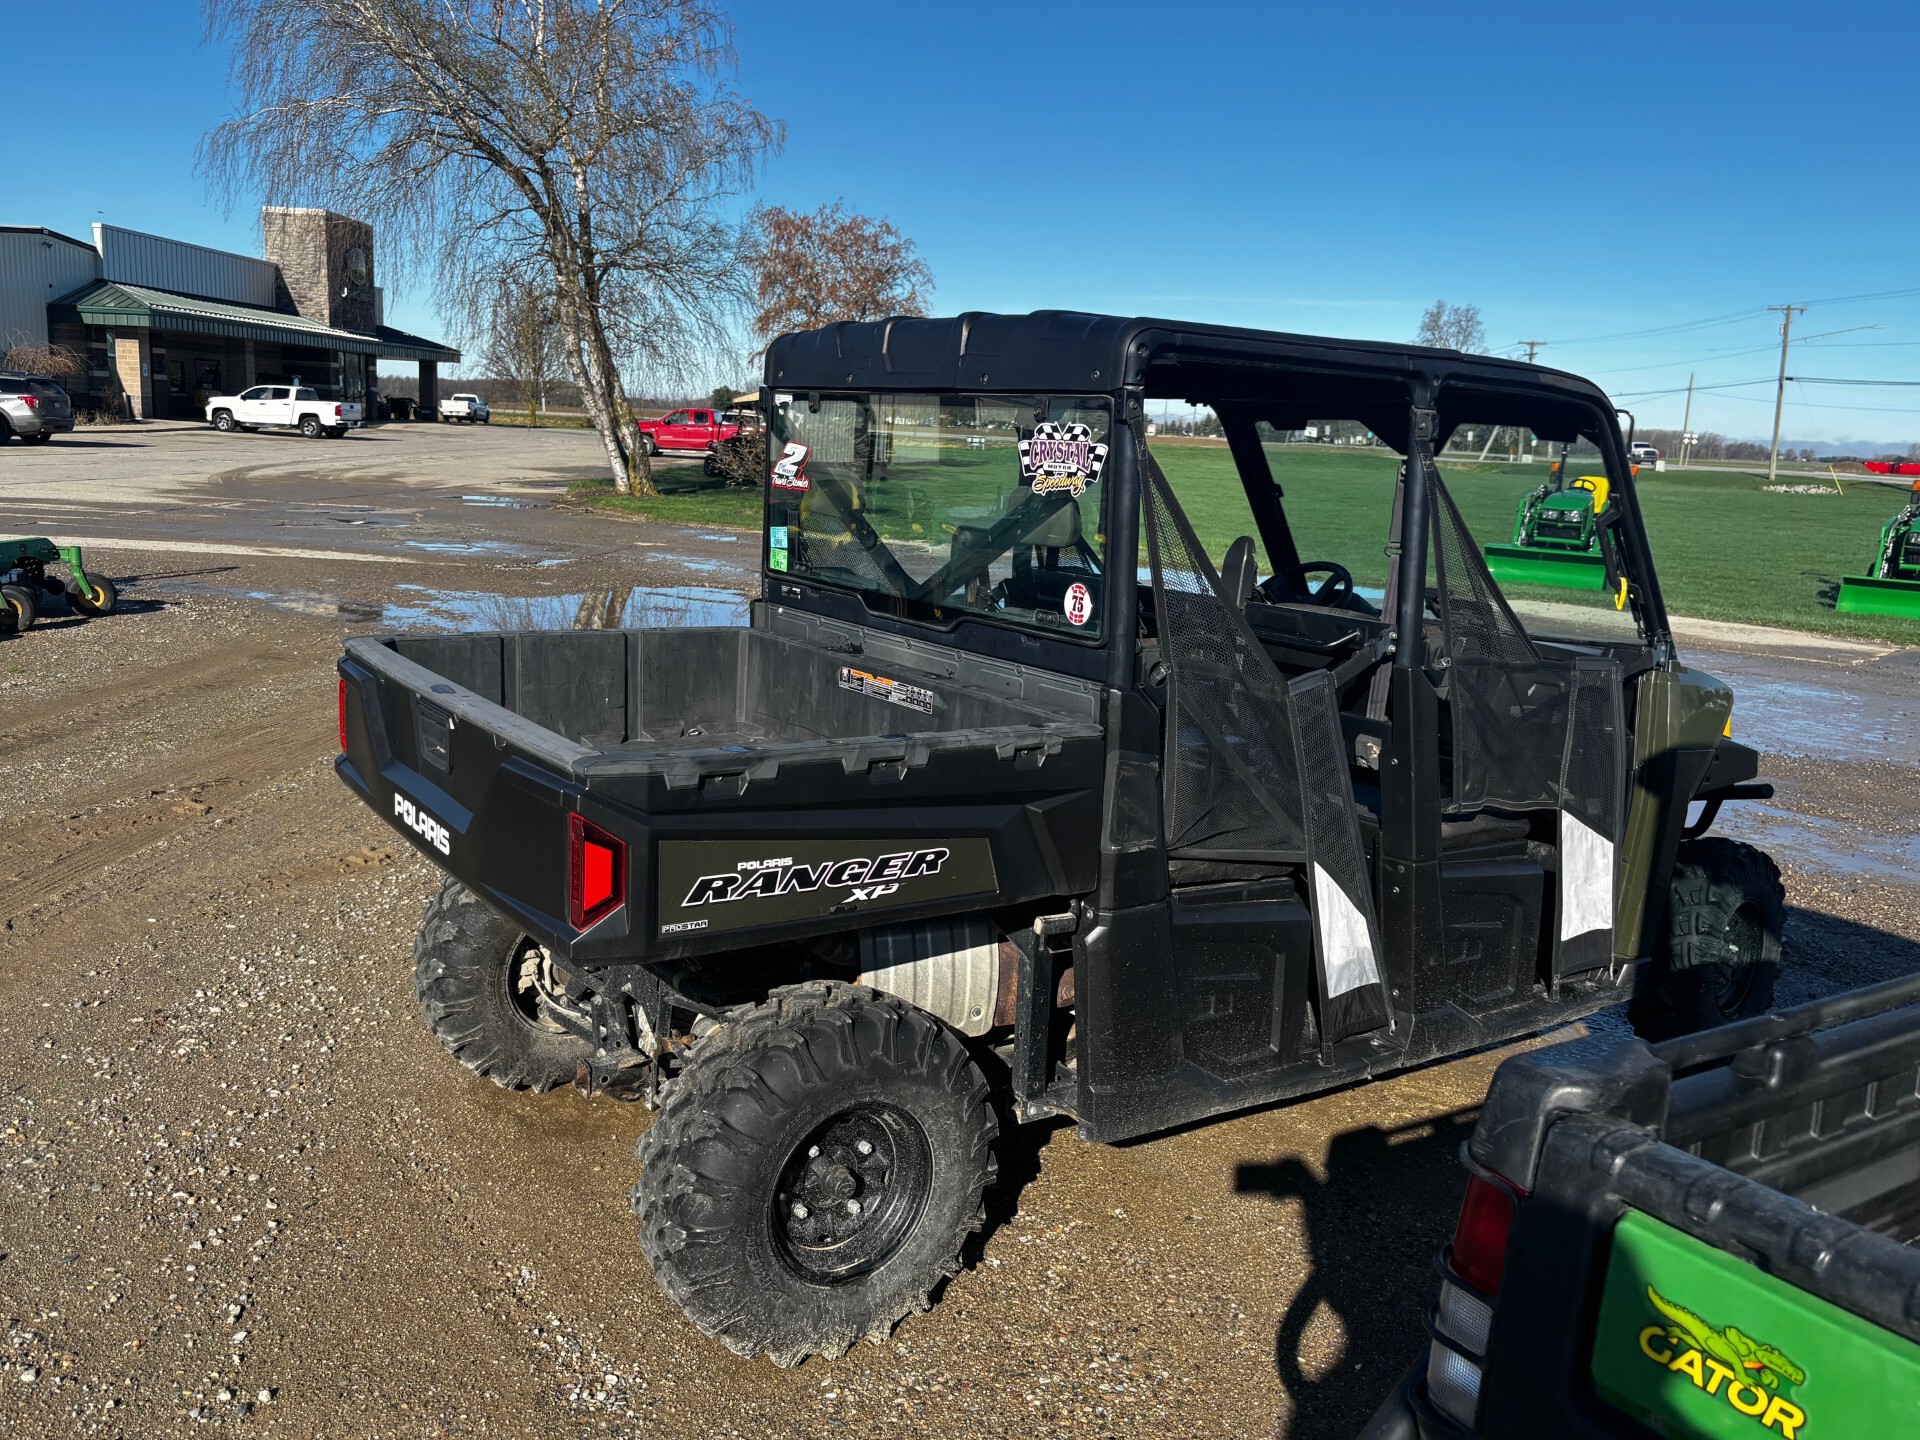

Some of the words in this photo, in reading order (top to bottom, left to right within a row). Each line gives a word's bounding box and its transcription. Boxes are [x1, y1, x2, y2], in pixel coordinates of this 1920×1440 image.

[773, 442, 808, 477] 2
[1029, 439, 1091, 474] CRYSTAL
[1033, 474, 1086, 497] Speedway
[1072, 594, 1084, 613] 75
[394, 792, 450, 856] POLARIS
[680, 847, 950, 907] RANGER
[737, 857, 793, 871] POLARIS
[841, 883, 900, 904] XP
[661, 919, 709, 934] PROSTAR
[1639, 1326, 1805, 1440] GATOR
